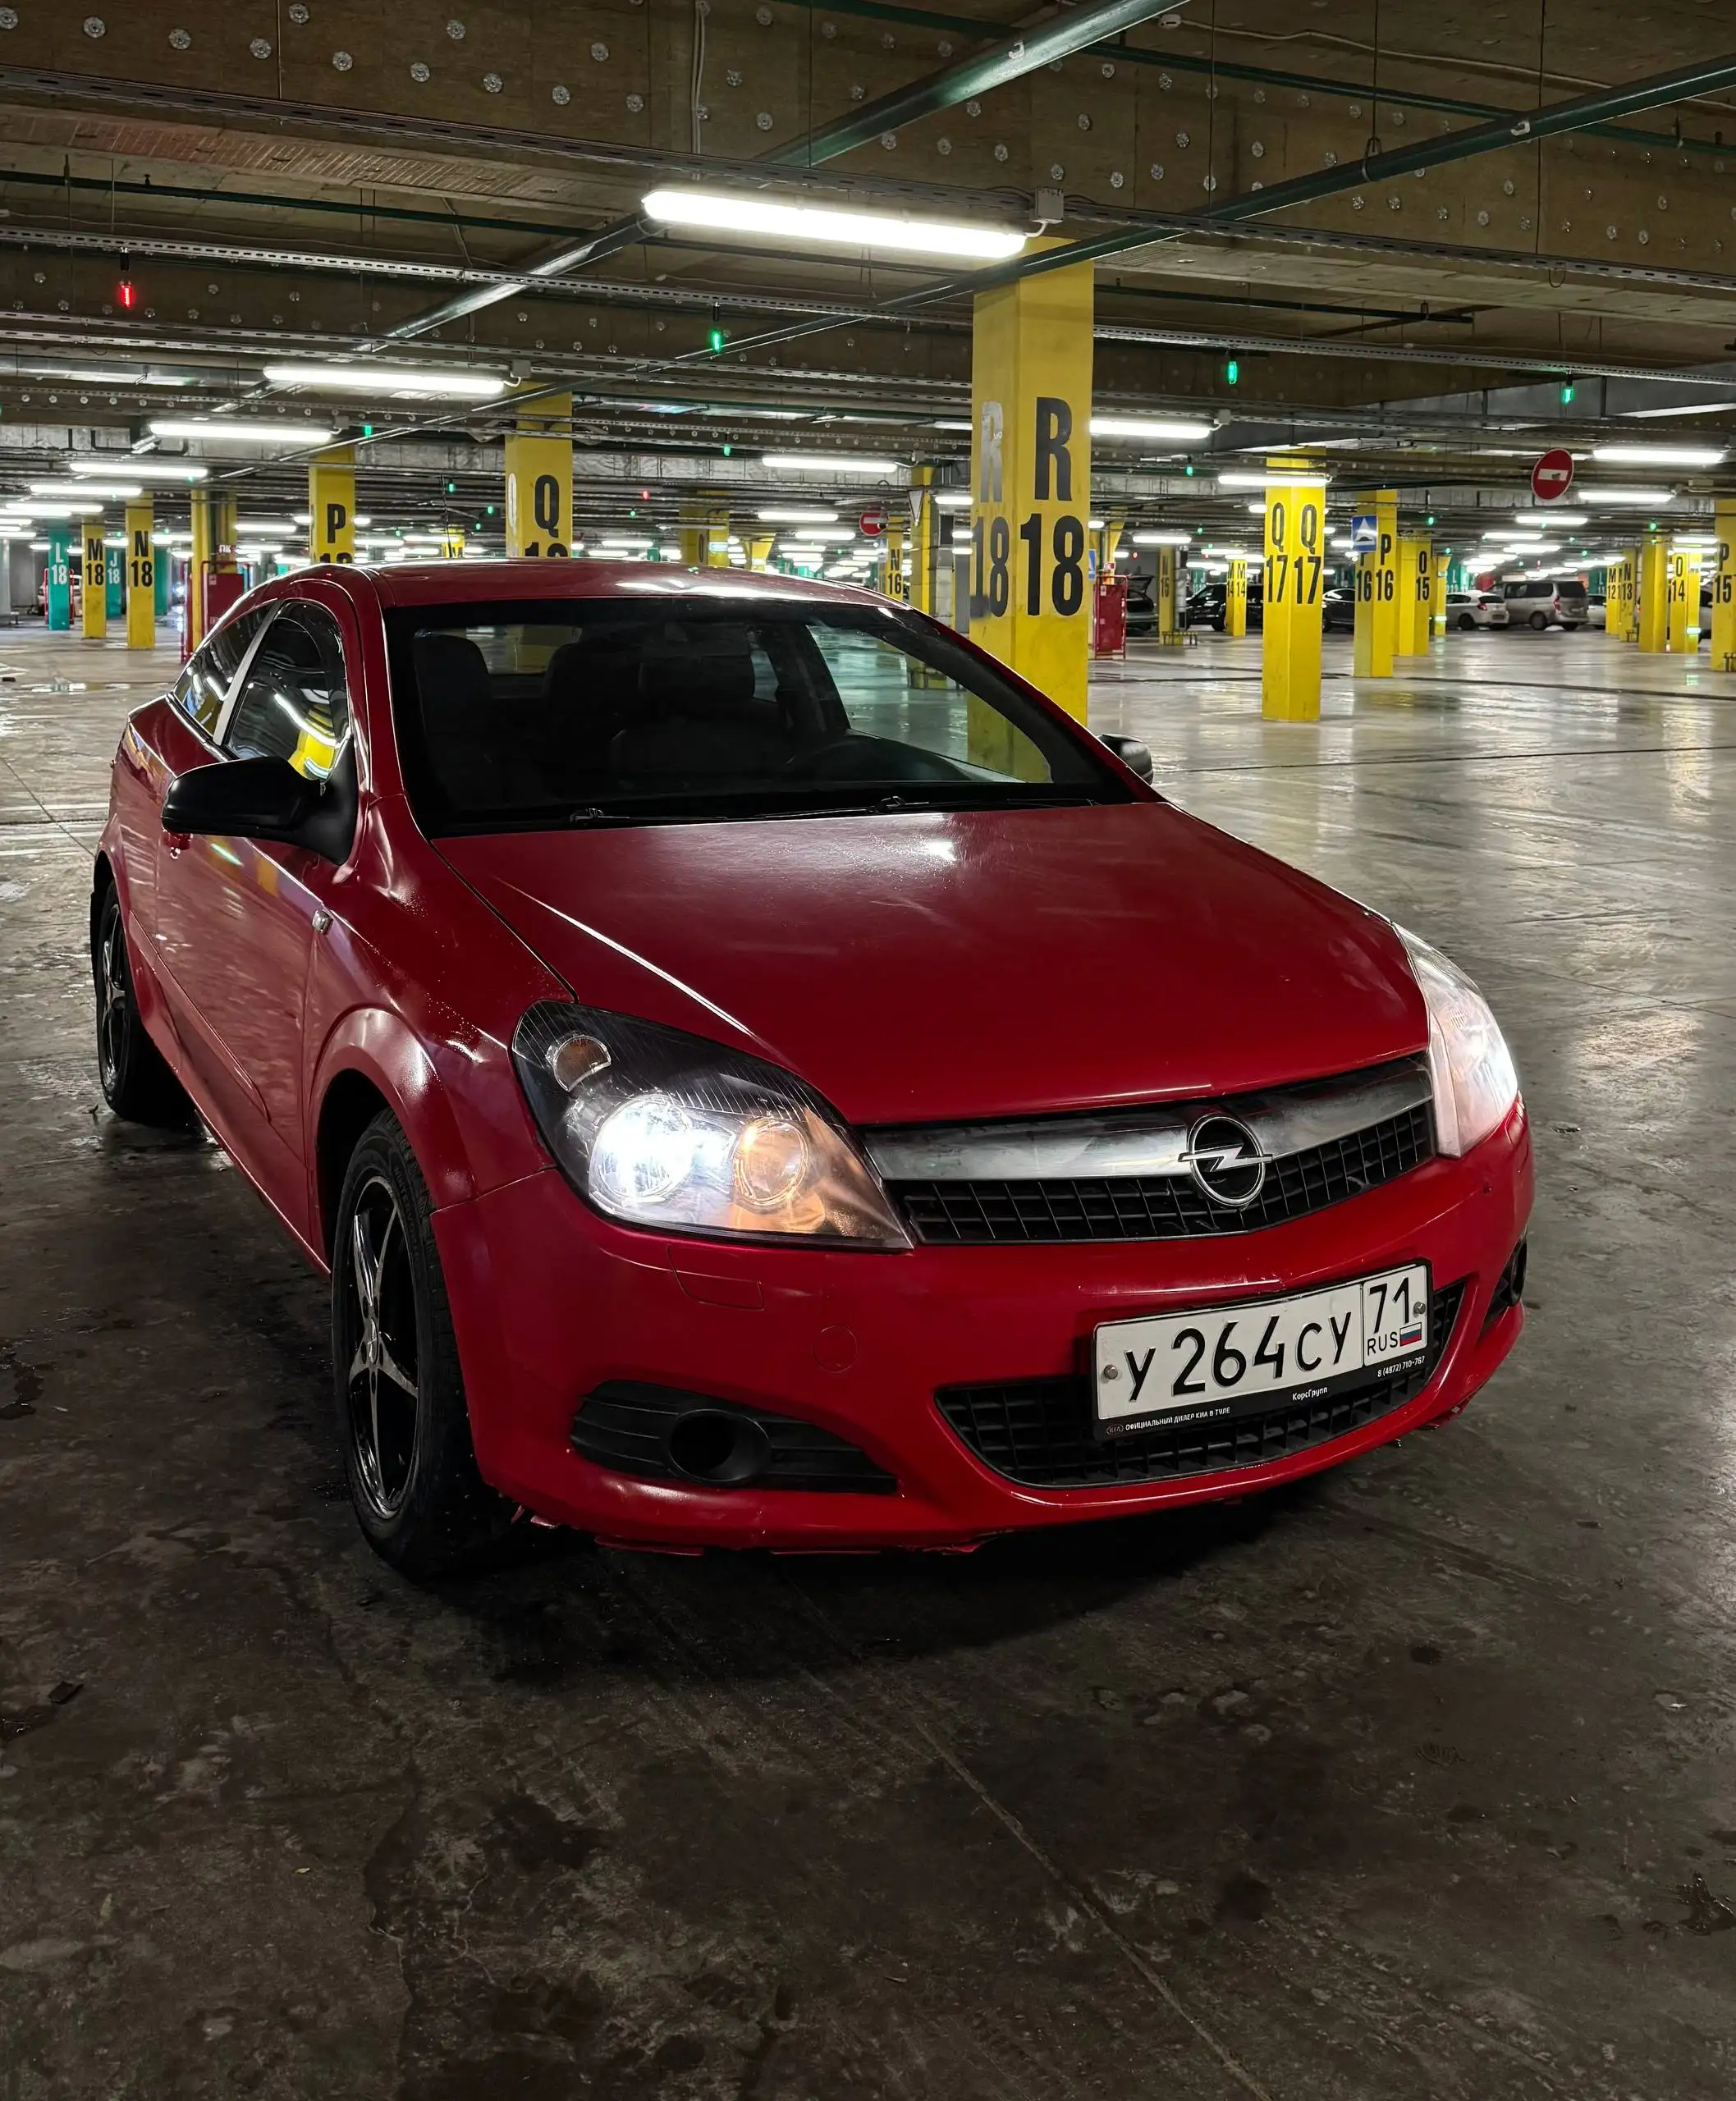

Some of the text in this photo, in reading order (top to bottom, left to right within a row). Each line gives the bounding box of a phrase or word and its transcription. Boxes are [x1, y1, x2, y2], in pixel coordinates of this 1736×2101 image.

[980, 401, 1003, 503] R
[1034, 396, 1073, 501] R
[534, 474, 560, 538] Q
[327, 503, 346, 543] P
[1271, 502, 1285, 552] Q
[1301, 504, 1317, 555] Q
[56, 542, 63, 563] L
[88, 538, 103, 561] M
[135, 530, 149, 557] N
[1381, 533, 1391, 565] P
[1720, 542, 1729, 572] P
[109, 551, 117, 567] J
[891, 549, 900, 570] N
[971, 515, 1010, 618] 18
[1020, 512, 1084, 616] 18
[1237, 562, 1245, 579] M
[1624, 563, 1632, 581] N
[51, 564, 67, 584] 18
[85, 562, 104, 585] 18
[108, 568, 120, 584] 18
[131, 560, 153, 587] 18
[887, 573, 901, 594] 16
[1266, 554, 1288, 602] 17
[1294, 556, 1321, 604] 17
[1356, 569, 1373, 602] 16
[1376, 569, 1394, 601] 16
[1609, 568, 1616, 583] M
[1237, 581, 1245, 597] 14
[1416, 576, 1430, 601] 15
[1607, 584, 1616, 599] 12
[1622, 583, 1633, 600] 13
[1672, 580, 1685, 602] 14
[1715, 574, 1732, 603] 15
[1368, 1277, 1410, 1334] 71
[1367, 1330, 1399, 1357] RUS
[1377, 1369, 1382, 1378] 8
[1174, 1413, 1195, 1425] ДИЛЕР
[1215, 1407, 1230, 1416] ТУЛЕ
